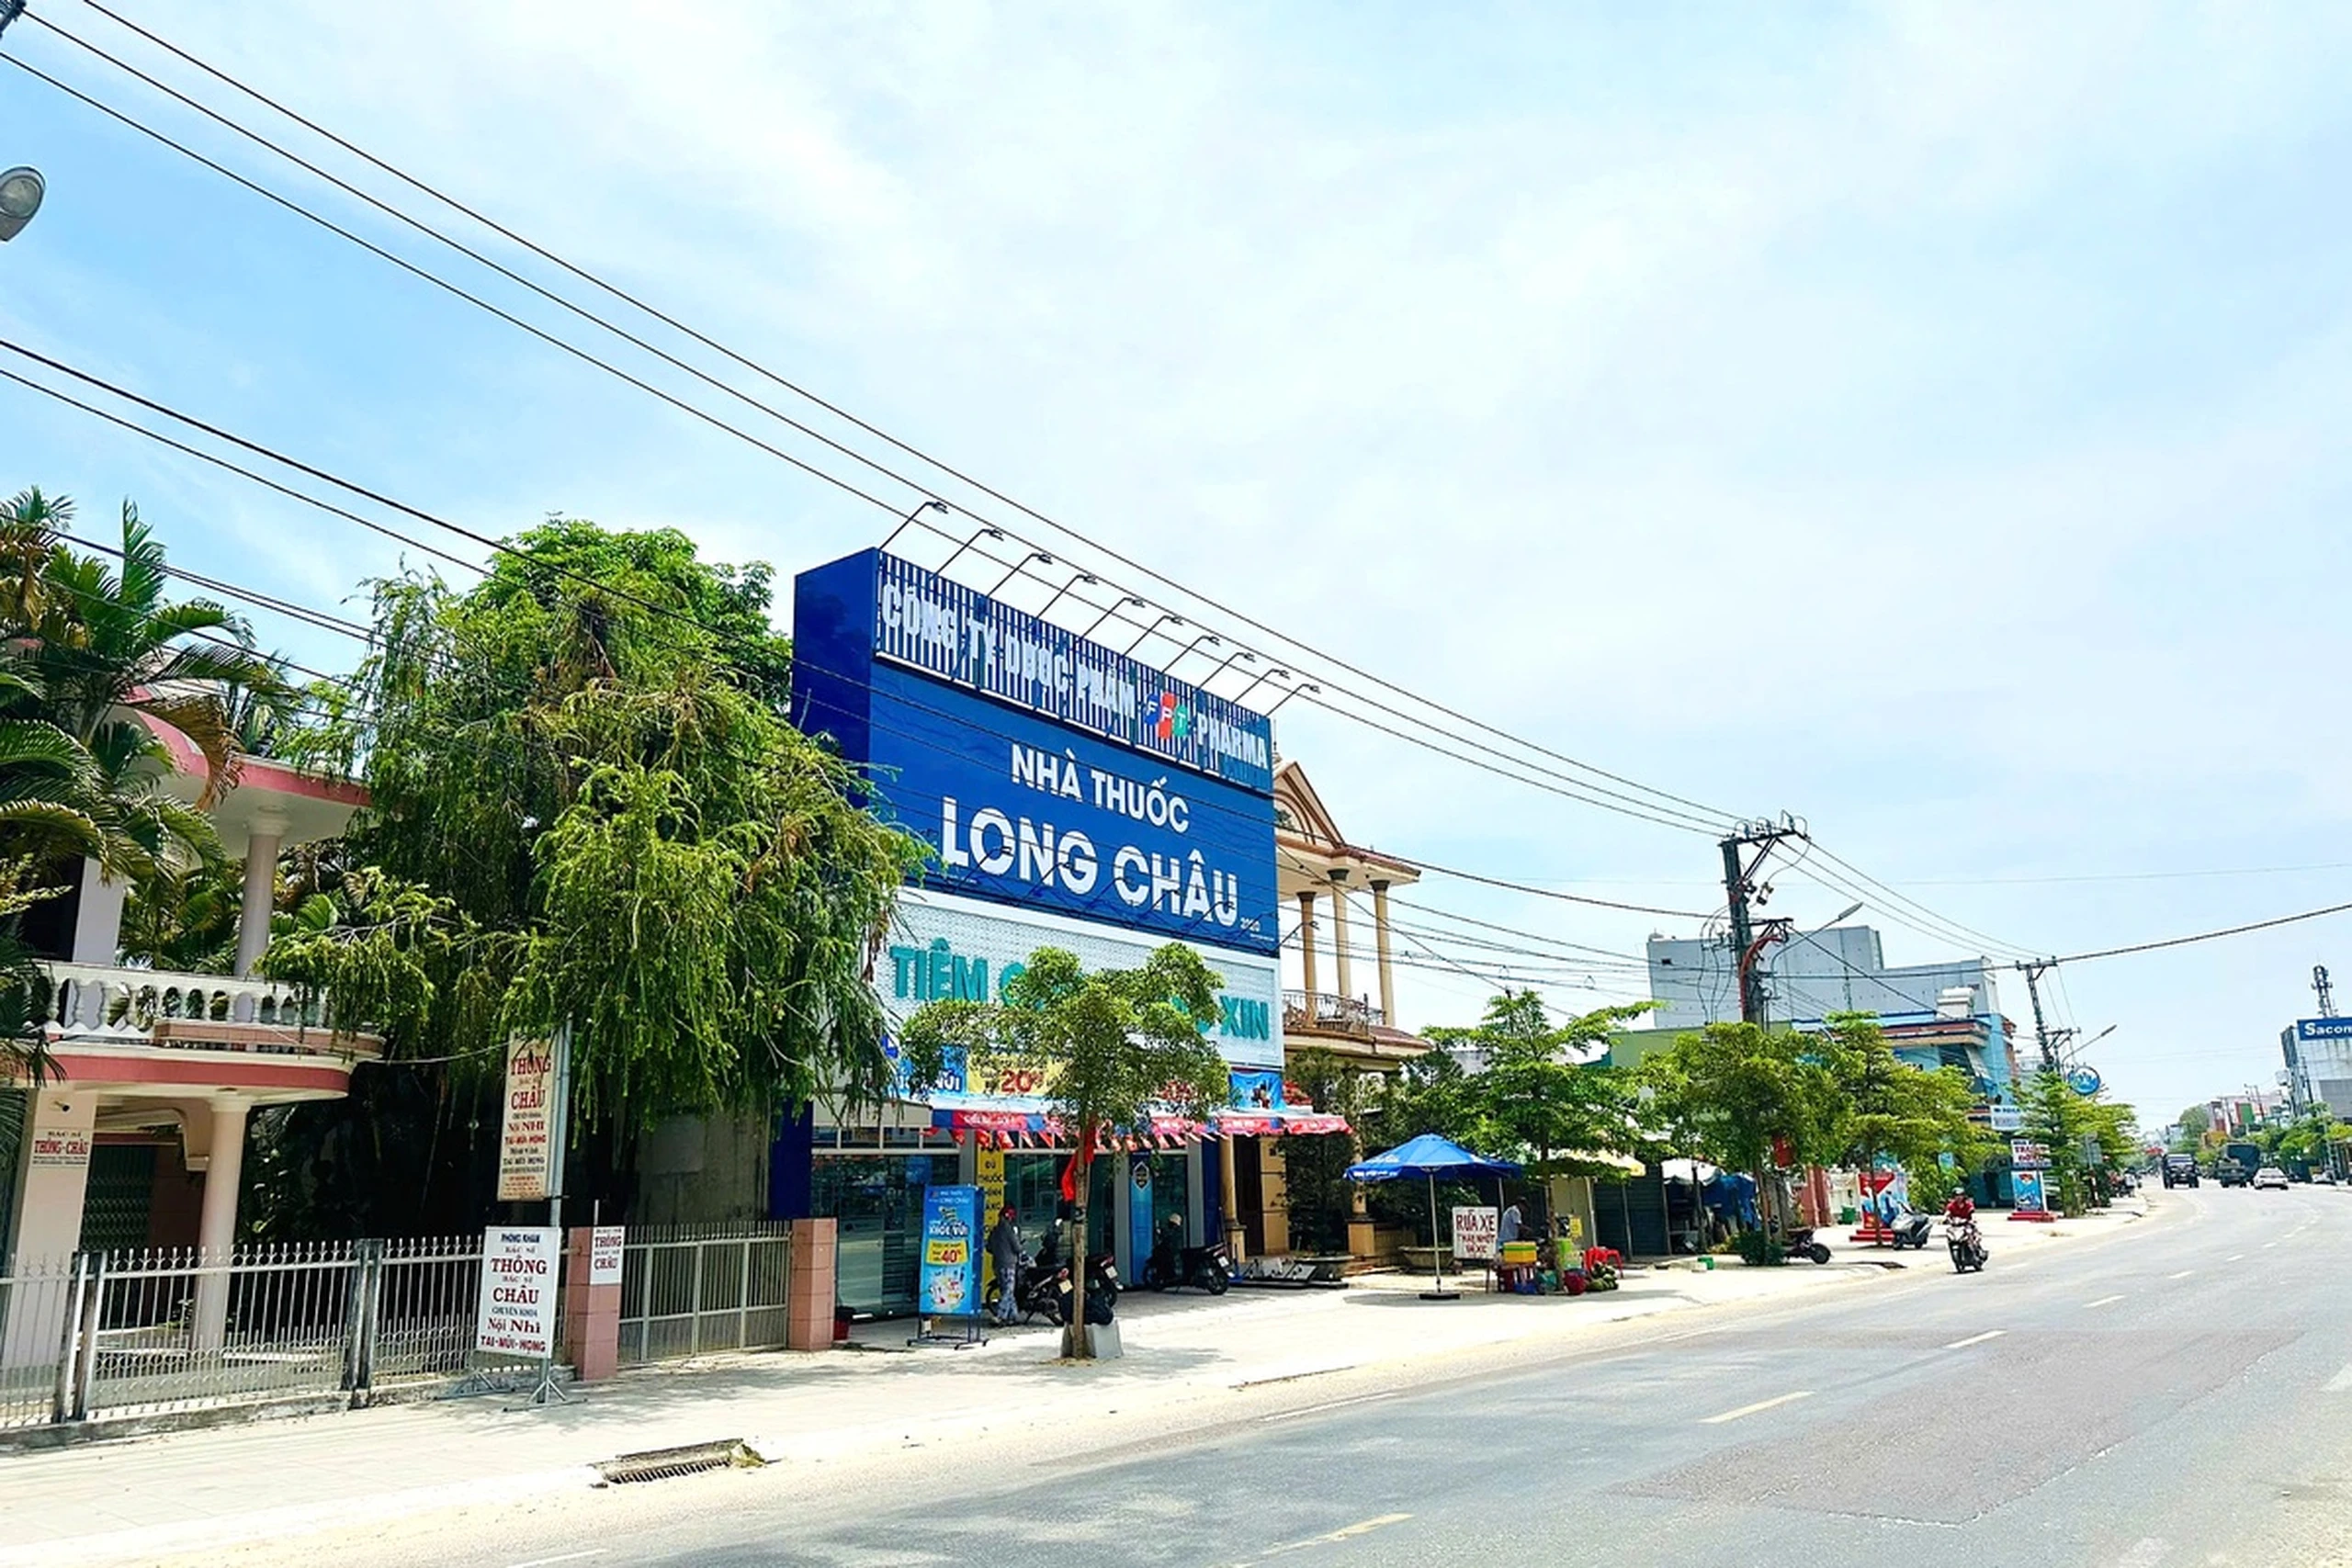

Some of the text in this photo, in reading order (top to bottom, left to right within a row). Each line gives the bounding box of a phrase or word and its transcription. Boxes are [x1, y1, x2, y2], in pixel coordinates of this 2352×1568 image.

[881, 582, 956, 650] CÔNG
[967, 617, 998, 667] TY
[1147, 698, 1187, 731] FPT
[1197, 712, 1269, 770] PHARMA
[1012, 743, 1189, 833] NHÀ THUỐC
[943, 796, 1238, 927] LONG CHÂU
[889, 937, 988, 1003] TIÊM
[1219, 996, 1269, 1041] XIN
[511, 1085, 546, 1110] CHÂU
[1479, 1214, 1496, 1232] XE
[491, 1255, 548, 1275] THÔNG
[493, 1285, 539, 1304] CHÂU
[488, 1317, 540, 1334] Nội Nhi
